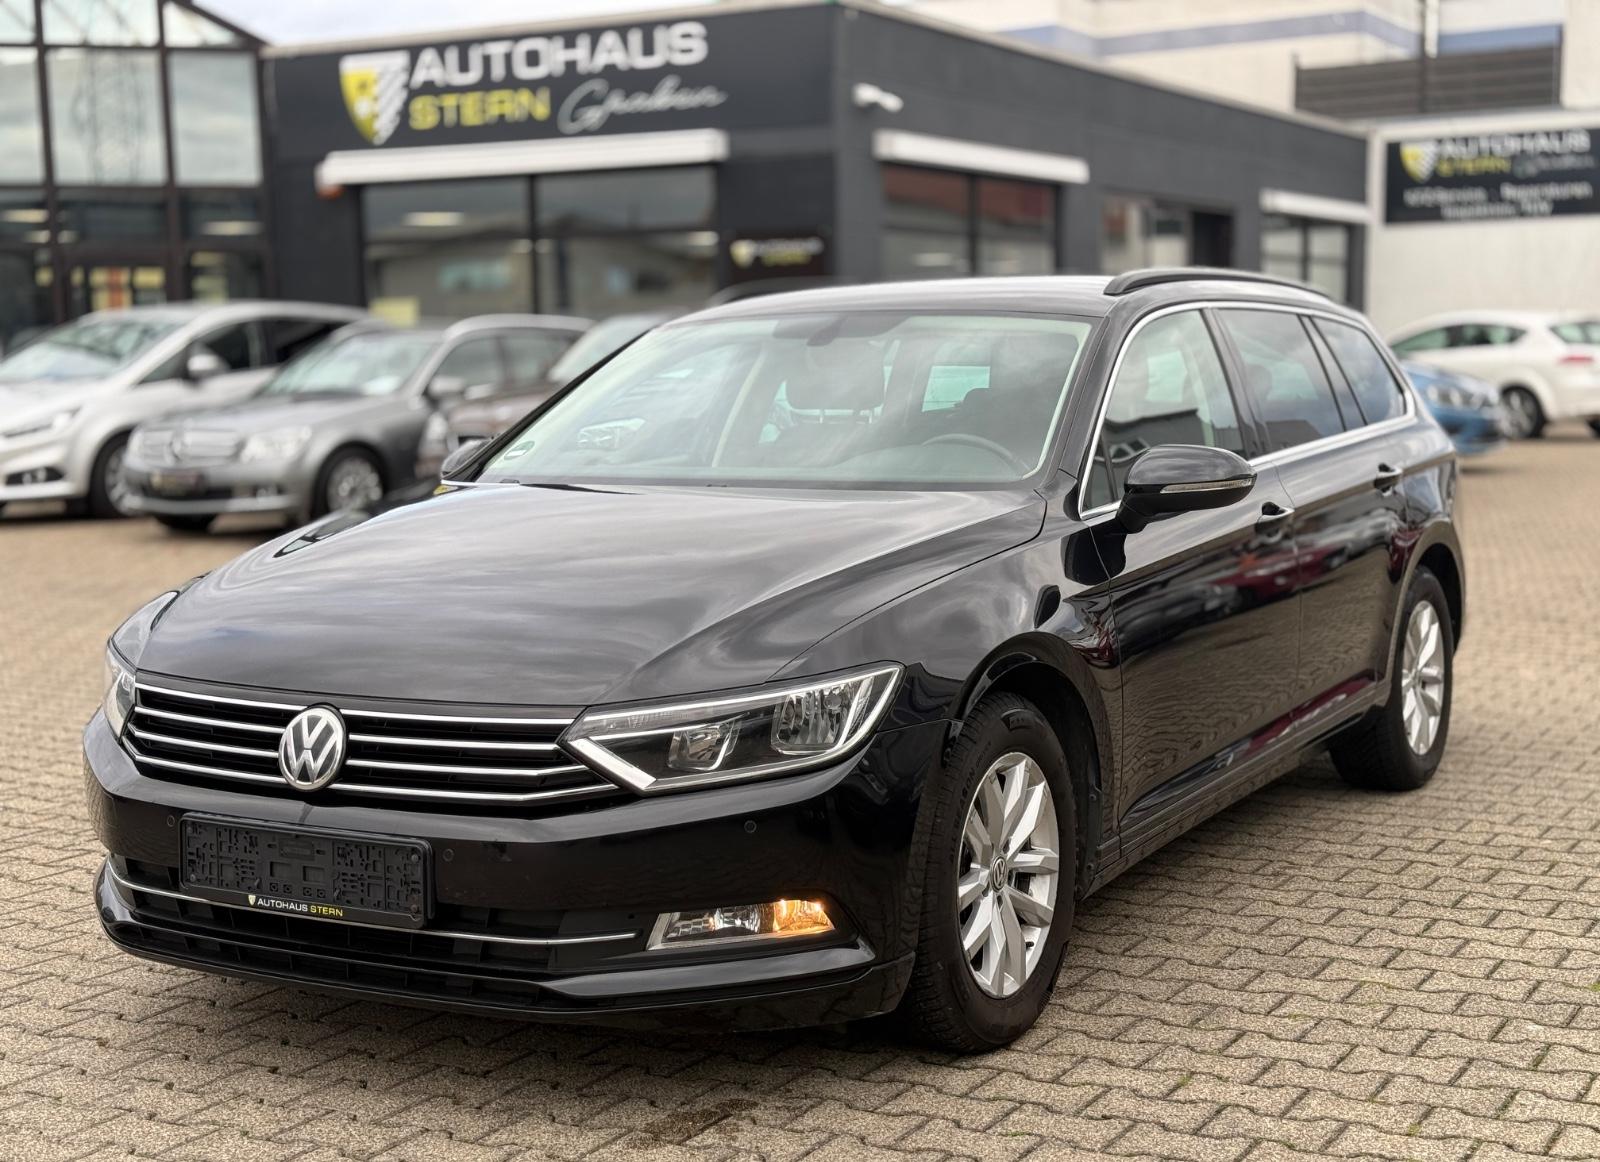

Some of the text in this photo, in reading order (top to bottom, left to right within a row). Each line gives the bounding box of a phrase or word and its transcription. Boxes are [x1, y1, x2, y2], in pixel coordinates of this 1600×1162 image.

[409, 21, 708, 88] AUTOHAUS
[408, 87, 551, 130] STERN
[281, 708, 342, 787] VW
[257, 898, 343, 917] AUTOHAUS STERN
